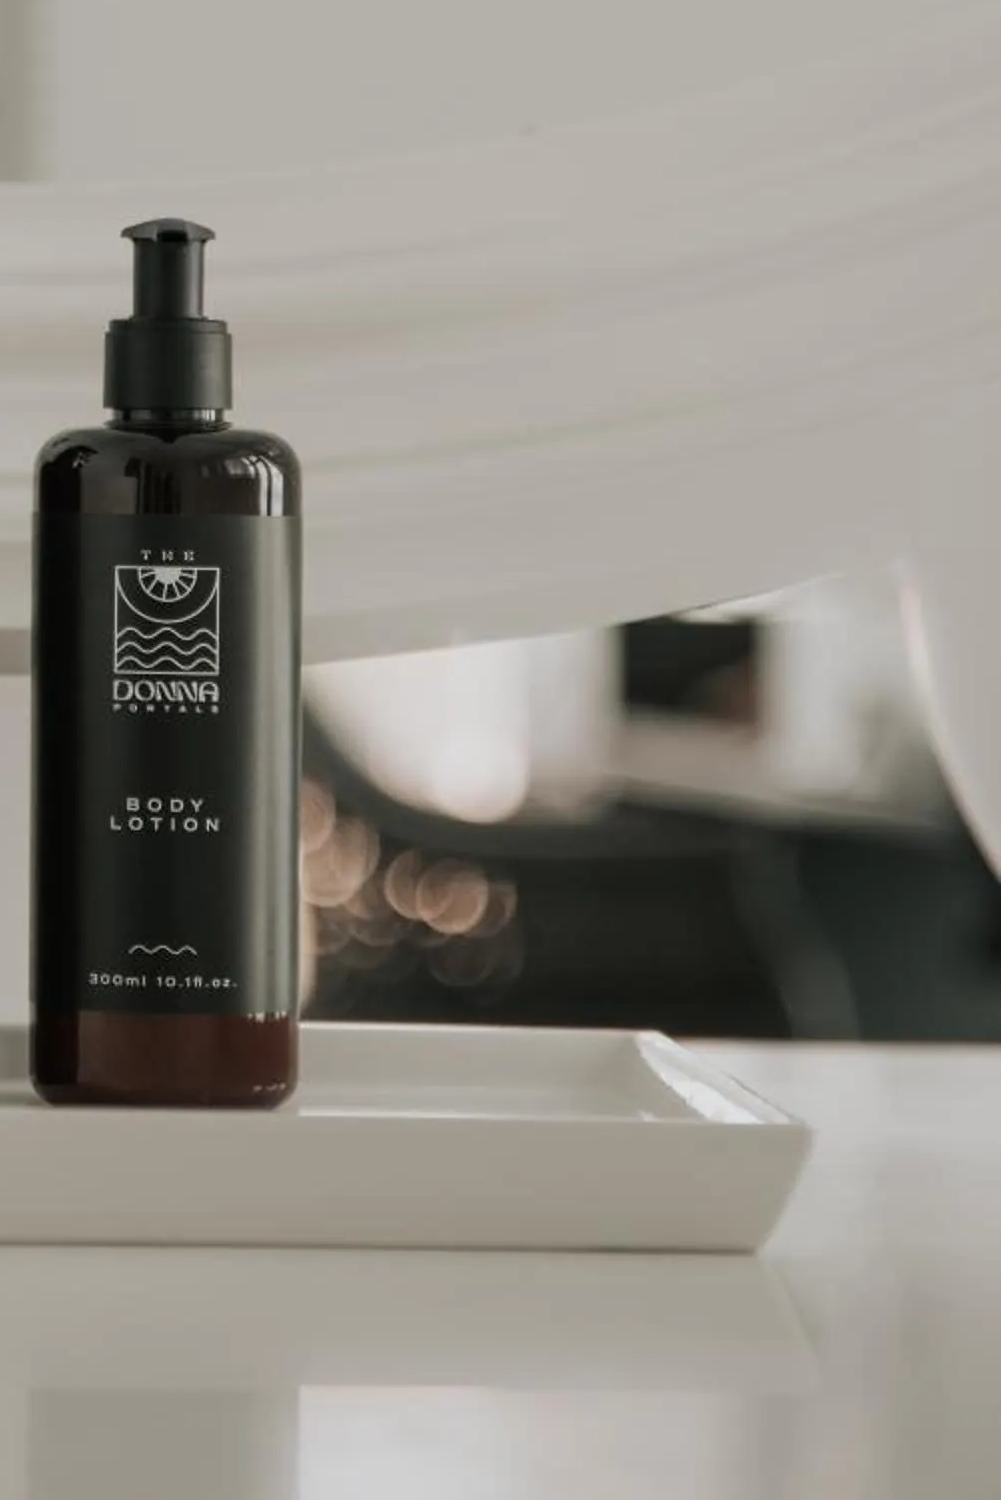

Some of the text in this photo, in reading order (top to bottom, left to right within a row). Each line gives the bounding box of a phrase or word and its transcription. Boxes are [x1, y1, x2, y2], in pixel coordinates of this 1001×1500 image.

[140, 549, 195, 562] THE
[112, 679, 220, 703] DONNA
[125, 796, 204, 813] BODY
[109, 815, 221, 833] LOTION
[88, 972, 147, 987] 300ml
